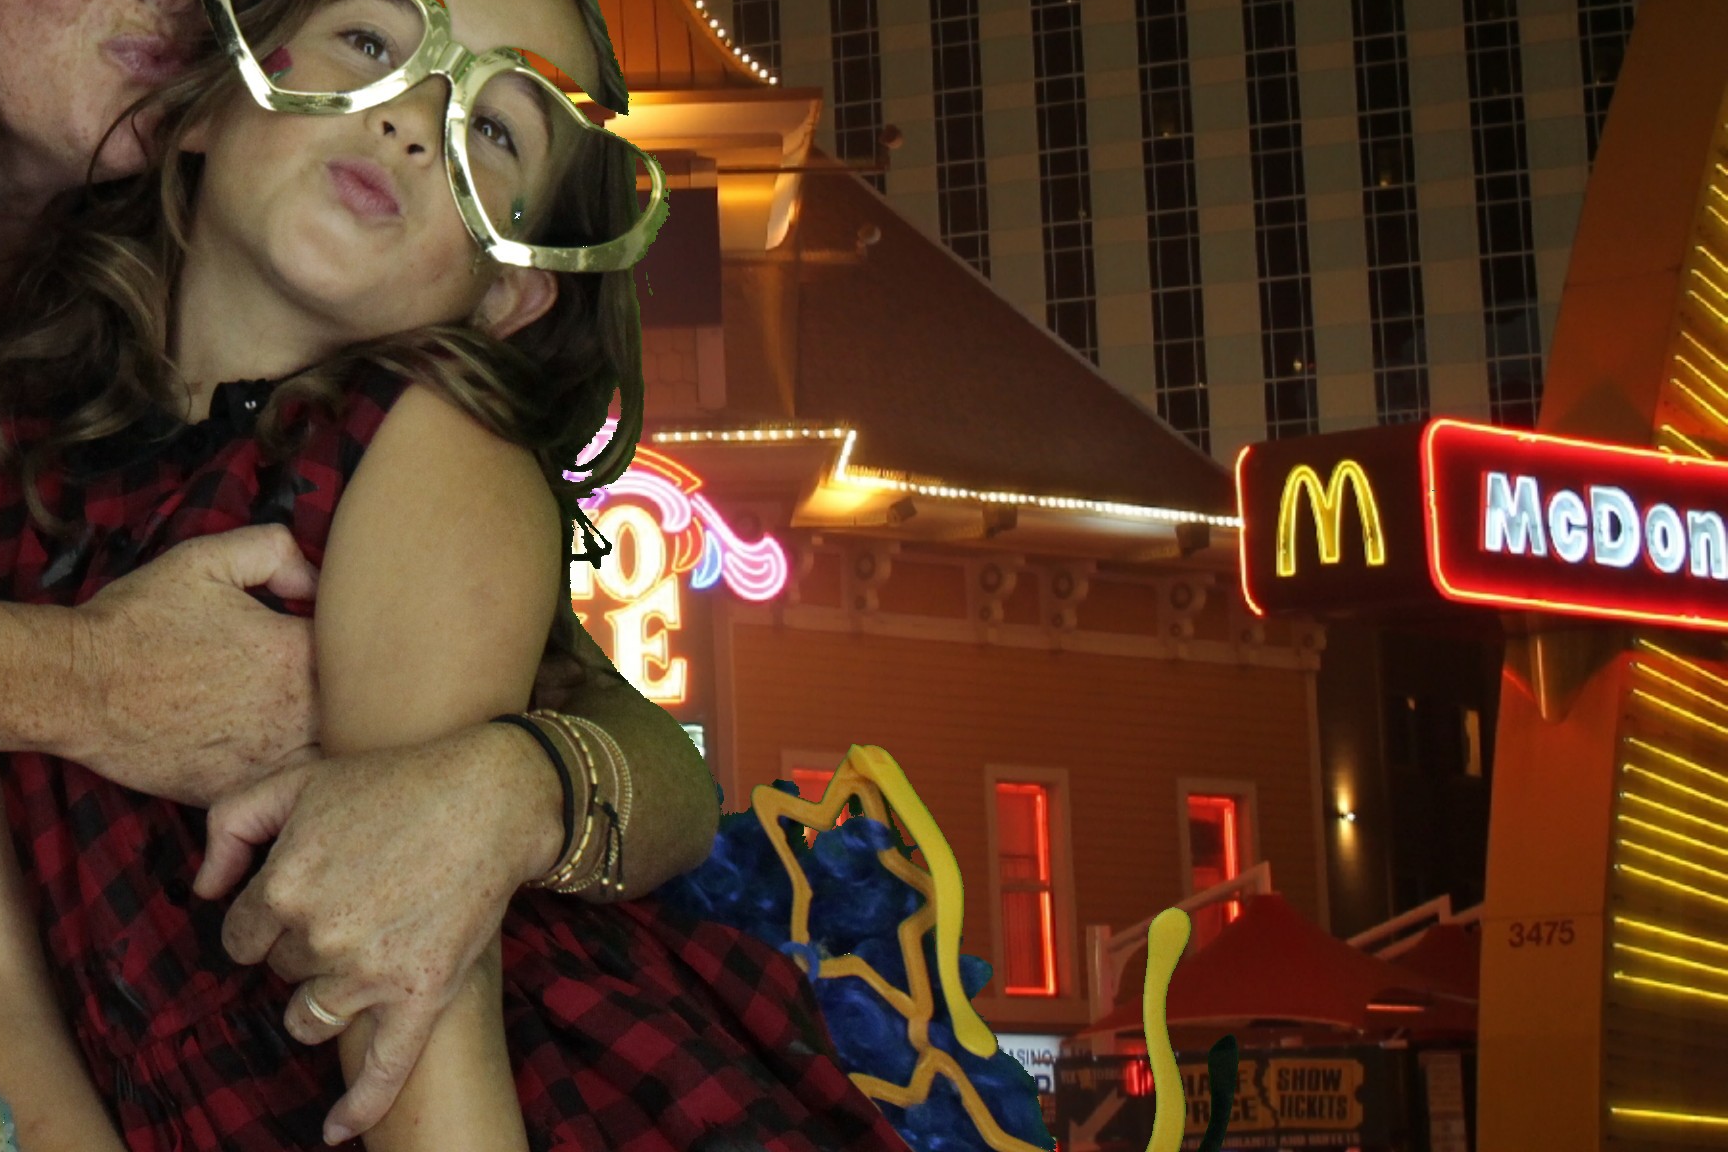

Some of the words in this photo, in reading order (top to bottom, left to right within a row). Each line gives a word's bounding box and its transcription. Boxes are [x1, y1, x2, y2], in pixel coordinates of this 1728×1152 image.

[1508, 920, 1575, 948] 3475
[1000, 1046, 1052, 1066] ASINO
[1277, 1067, 1343, 1092] SHOW
[1279, 1094, 1348, 1119] TICKETS
